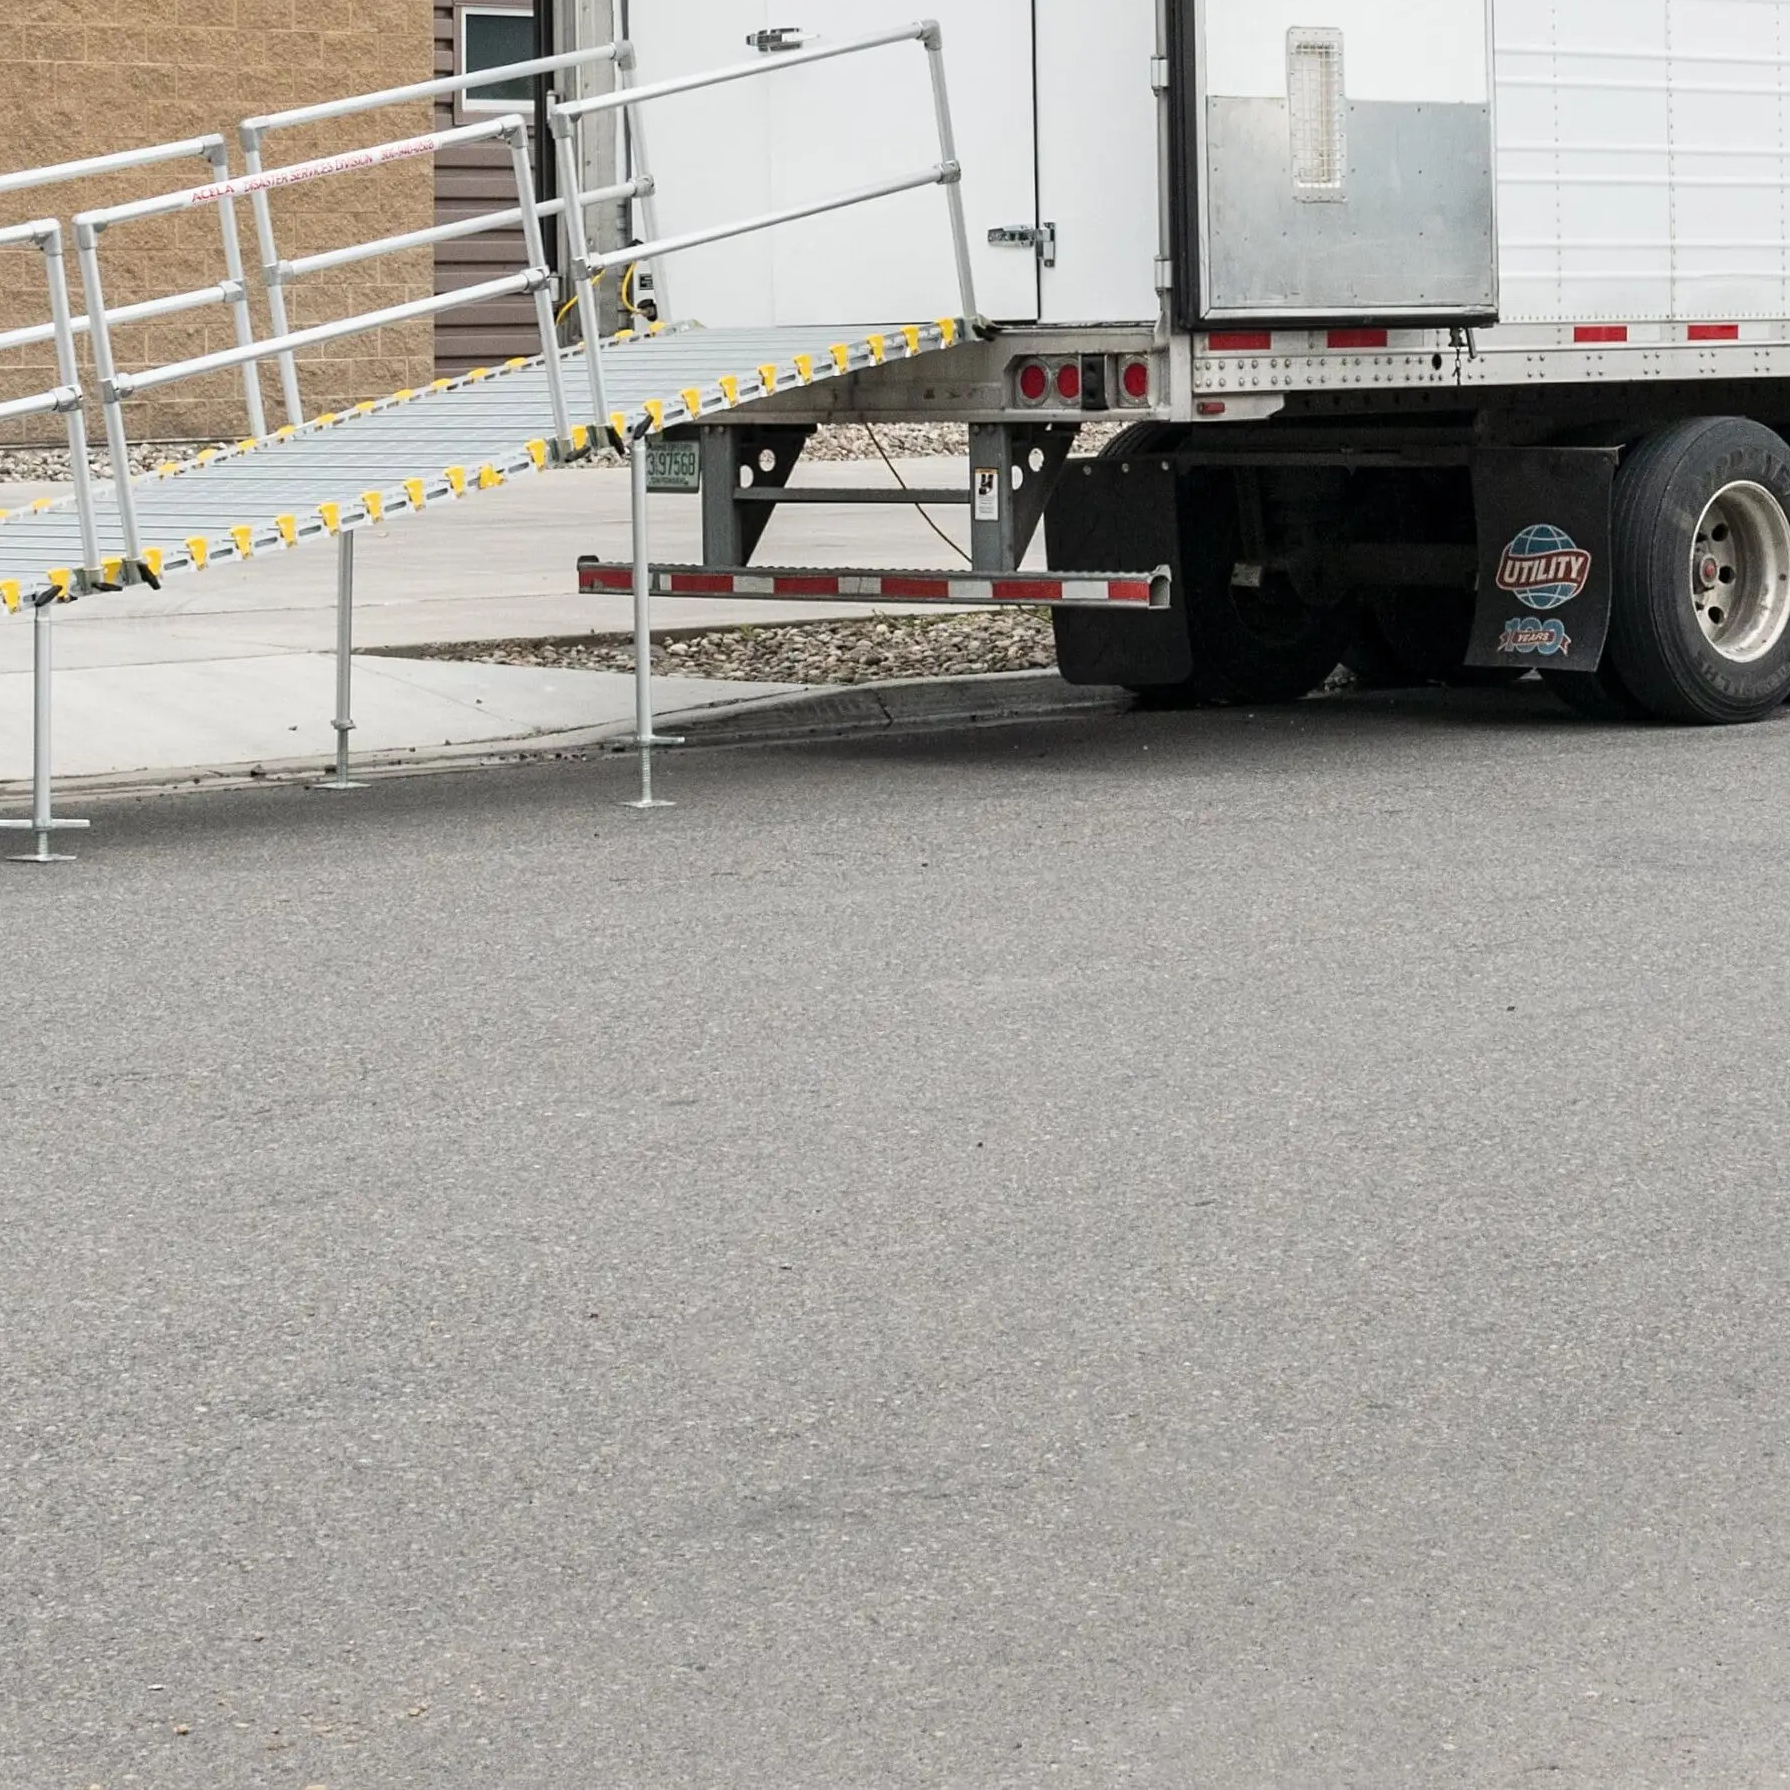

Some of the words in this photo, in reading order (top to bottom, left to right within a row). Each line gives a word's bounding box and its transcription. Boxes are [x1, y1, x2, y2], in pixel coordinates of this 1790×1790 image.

[191, 184, 235, 202] ACELA
[1503, 555, 1584, 584] UTILITY
[1517, 632, 1549, 643] YEARS
